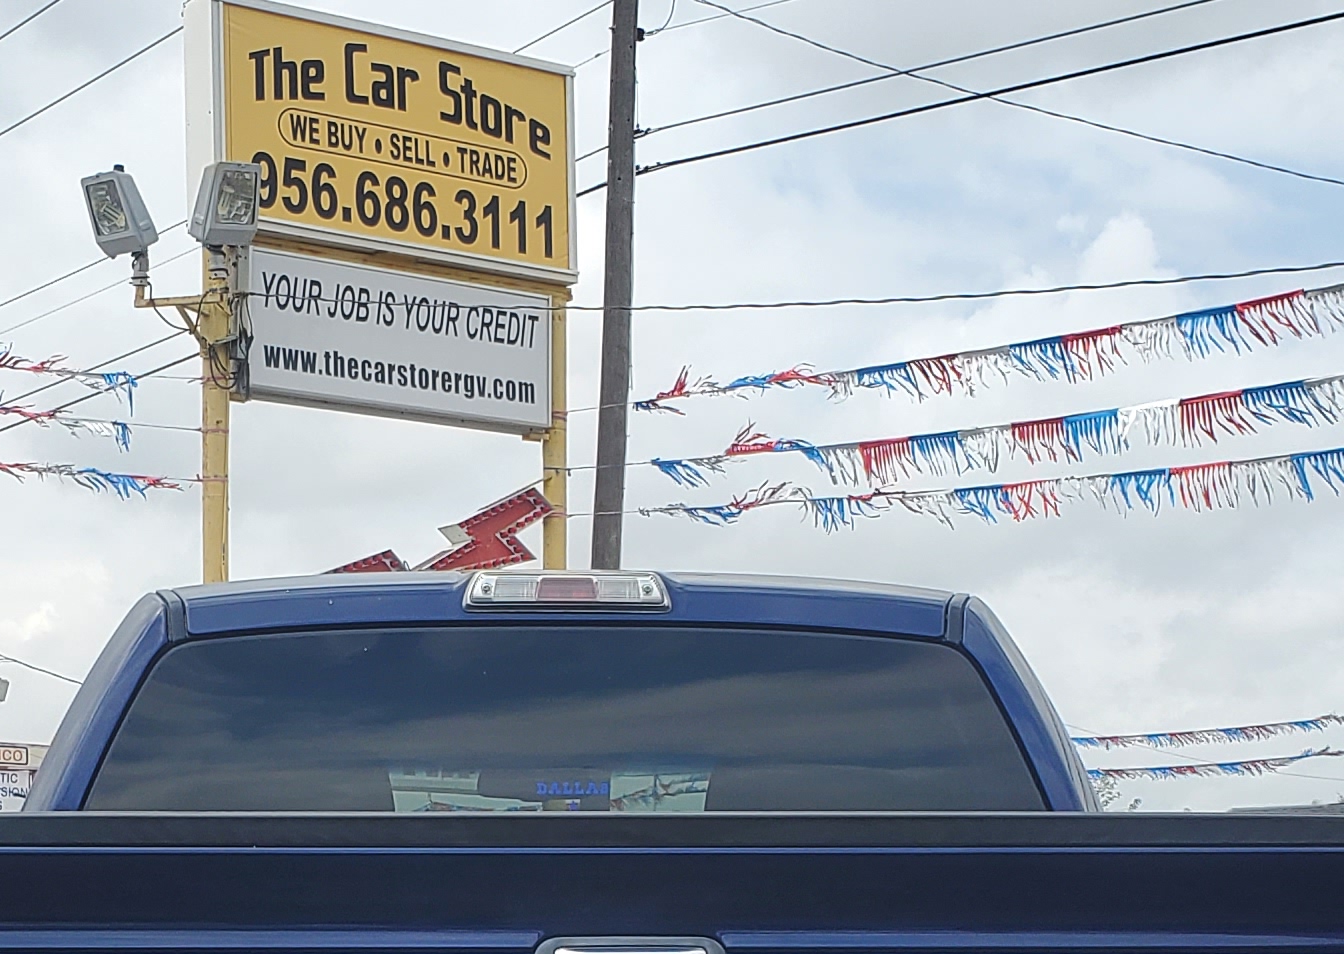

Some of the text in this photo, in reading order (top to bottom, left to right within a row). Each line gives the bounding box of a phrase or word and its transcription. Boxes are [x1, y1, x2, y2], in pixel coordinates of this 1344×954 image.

[248, 43, 551, 160] The Car Store
[289, 113, 518, 184] WE BUY SELL TRADE
[251, 152, 554, 259] 956.686.3111
[262, 271, 539, 349] YOUR JOB IS YOUR CREDIT
[264, 344, 536, 404] www.thecarstorergv.com
